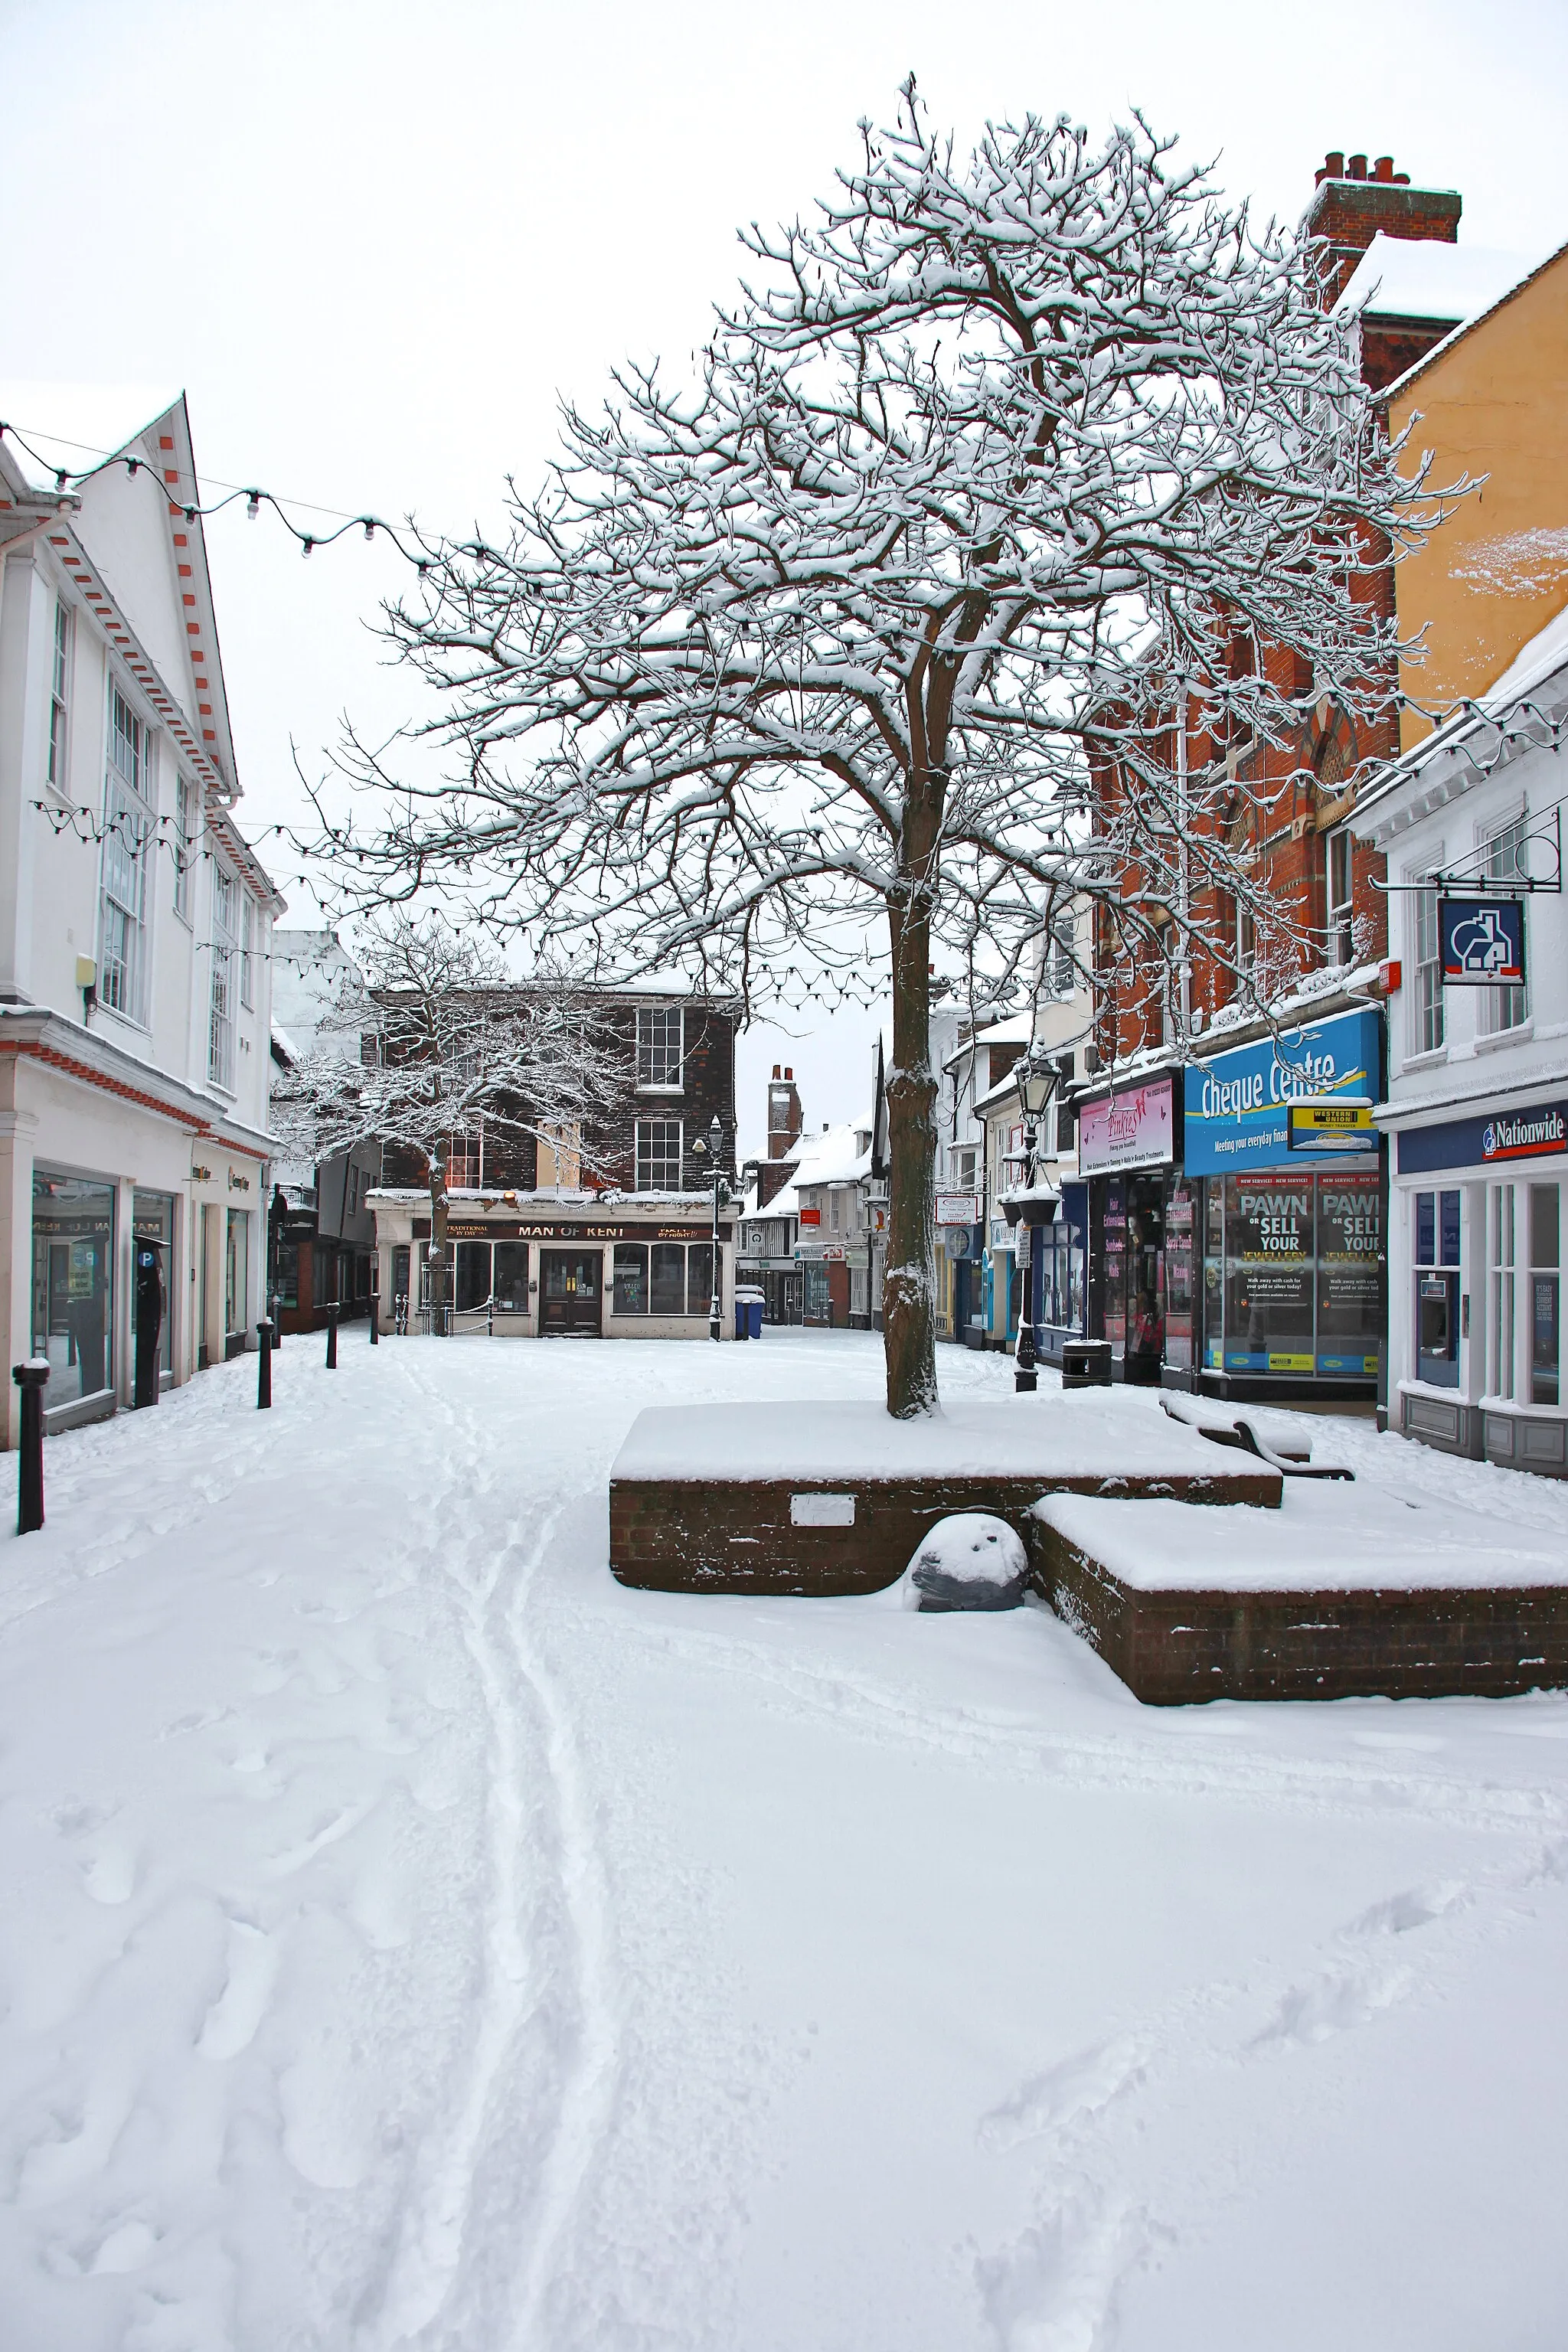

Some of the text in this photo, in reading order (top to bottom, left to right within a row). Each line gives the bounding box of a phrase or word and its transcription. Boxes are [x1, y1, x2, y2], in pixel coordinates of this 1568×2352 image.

[1201, 1050, 1335, 1124] Cheque Centre
[1108, 1110, 1137, 1141] Pinkies
[1496, 1112, 1564, 1148] Nationwide
[1214, 1138, 1235, 1154] Meeting
[1235, 1137, 1247, 1153] your
[1247, 1130, 1272, 1149] everyday
[1093, 1161, 1107, 1169] Extensions
[1146, 1150, 1164, 1160] Treatments
[1109, 1198, 1119, 1211] Hair
[1240, 1195, 1308, 1216] PAWN
[1323, 1194, 1379, 1216] PAW
[1103, 1214, 1126, 1227] Extensions
[1260, 1217, 1299, 1234] SELL
[518, 1227, 554, 1236] MAN
[560, 1227, 580, 1236] OF
[1106, 1239, 1123, 1252] Sunbeds
[1260, 1236, 1299, 1250] YOUR
[1241, 1251, 1306, 1263] JEWELLERY
[1109, 1264, 1120, 1277] Nails
